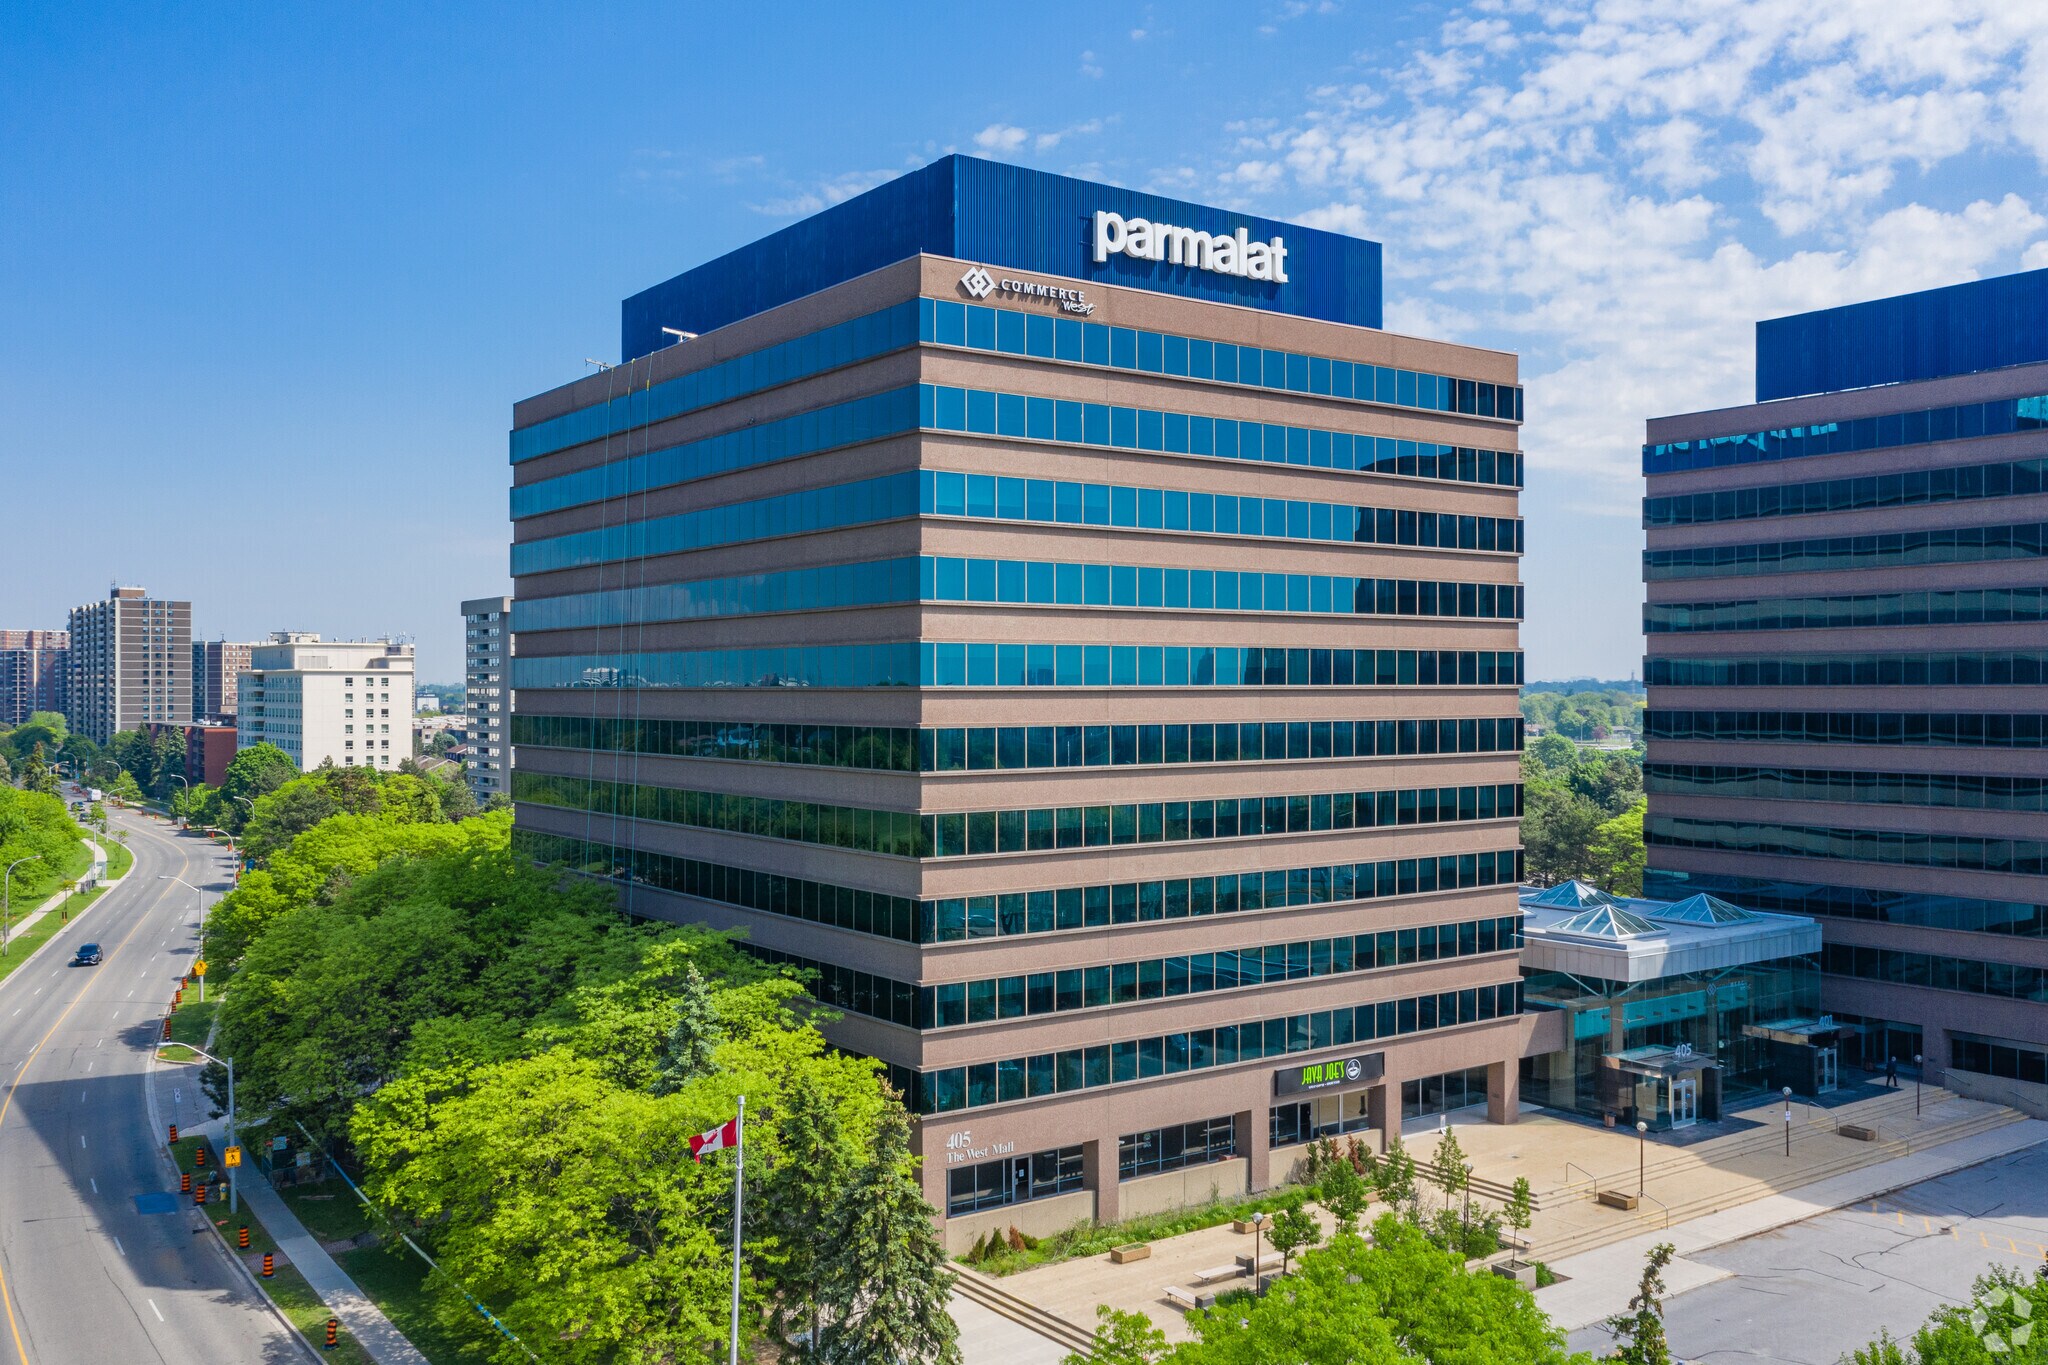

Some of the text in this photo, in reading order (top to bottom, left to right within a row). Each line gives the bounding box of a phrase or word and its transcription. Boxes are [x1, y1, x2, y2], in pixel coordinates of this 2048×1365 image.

[1092, 210, 1289, 284] parmalat
[1001, 278, 1085, 302] COMMERCE
[1818, 1014, 1833, 1027] 401
[1675, 1042, 1692, 1058] 405
[1301, 1064, 1323, 1086] JAVA
[1324, 1060, 1345, 1081] JOE'S
[946, 1130, 971, 1150] 405
[947, 1141, 1014, 1164] The West Mall
